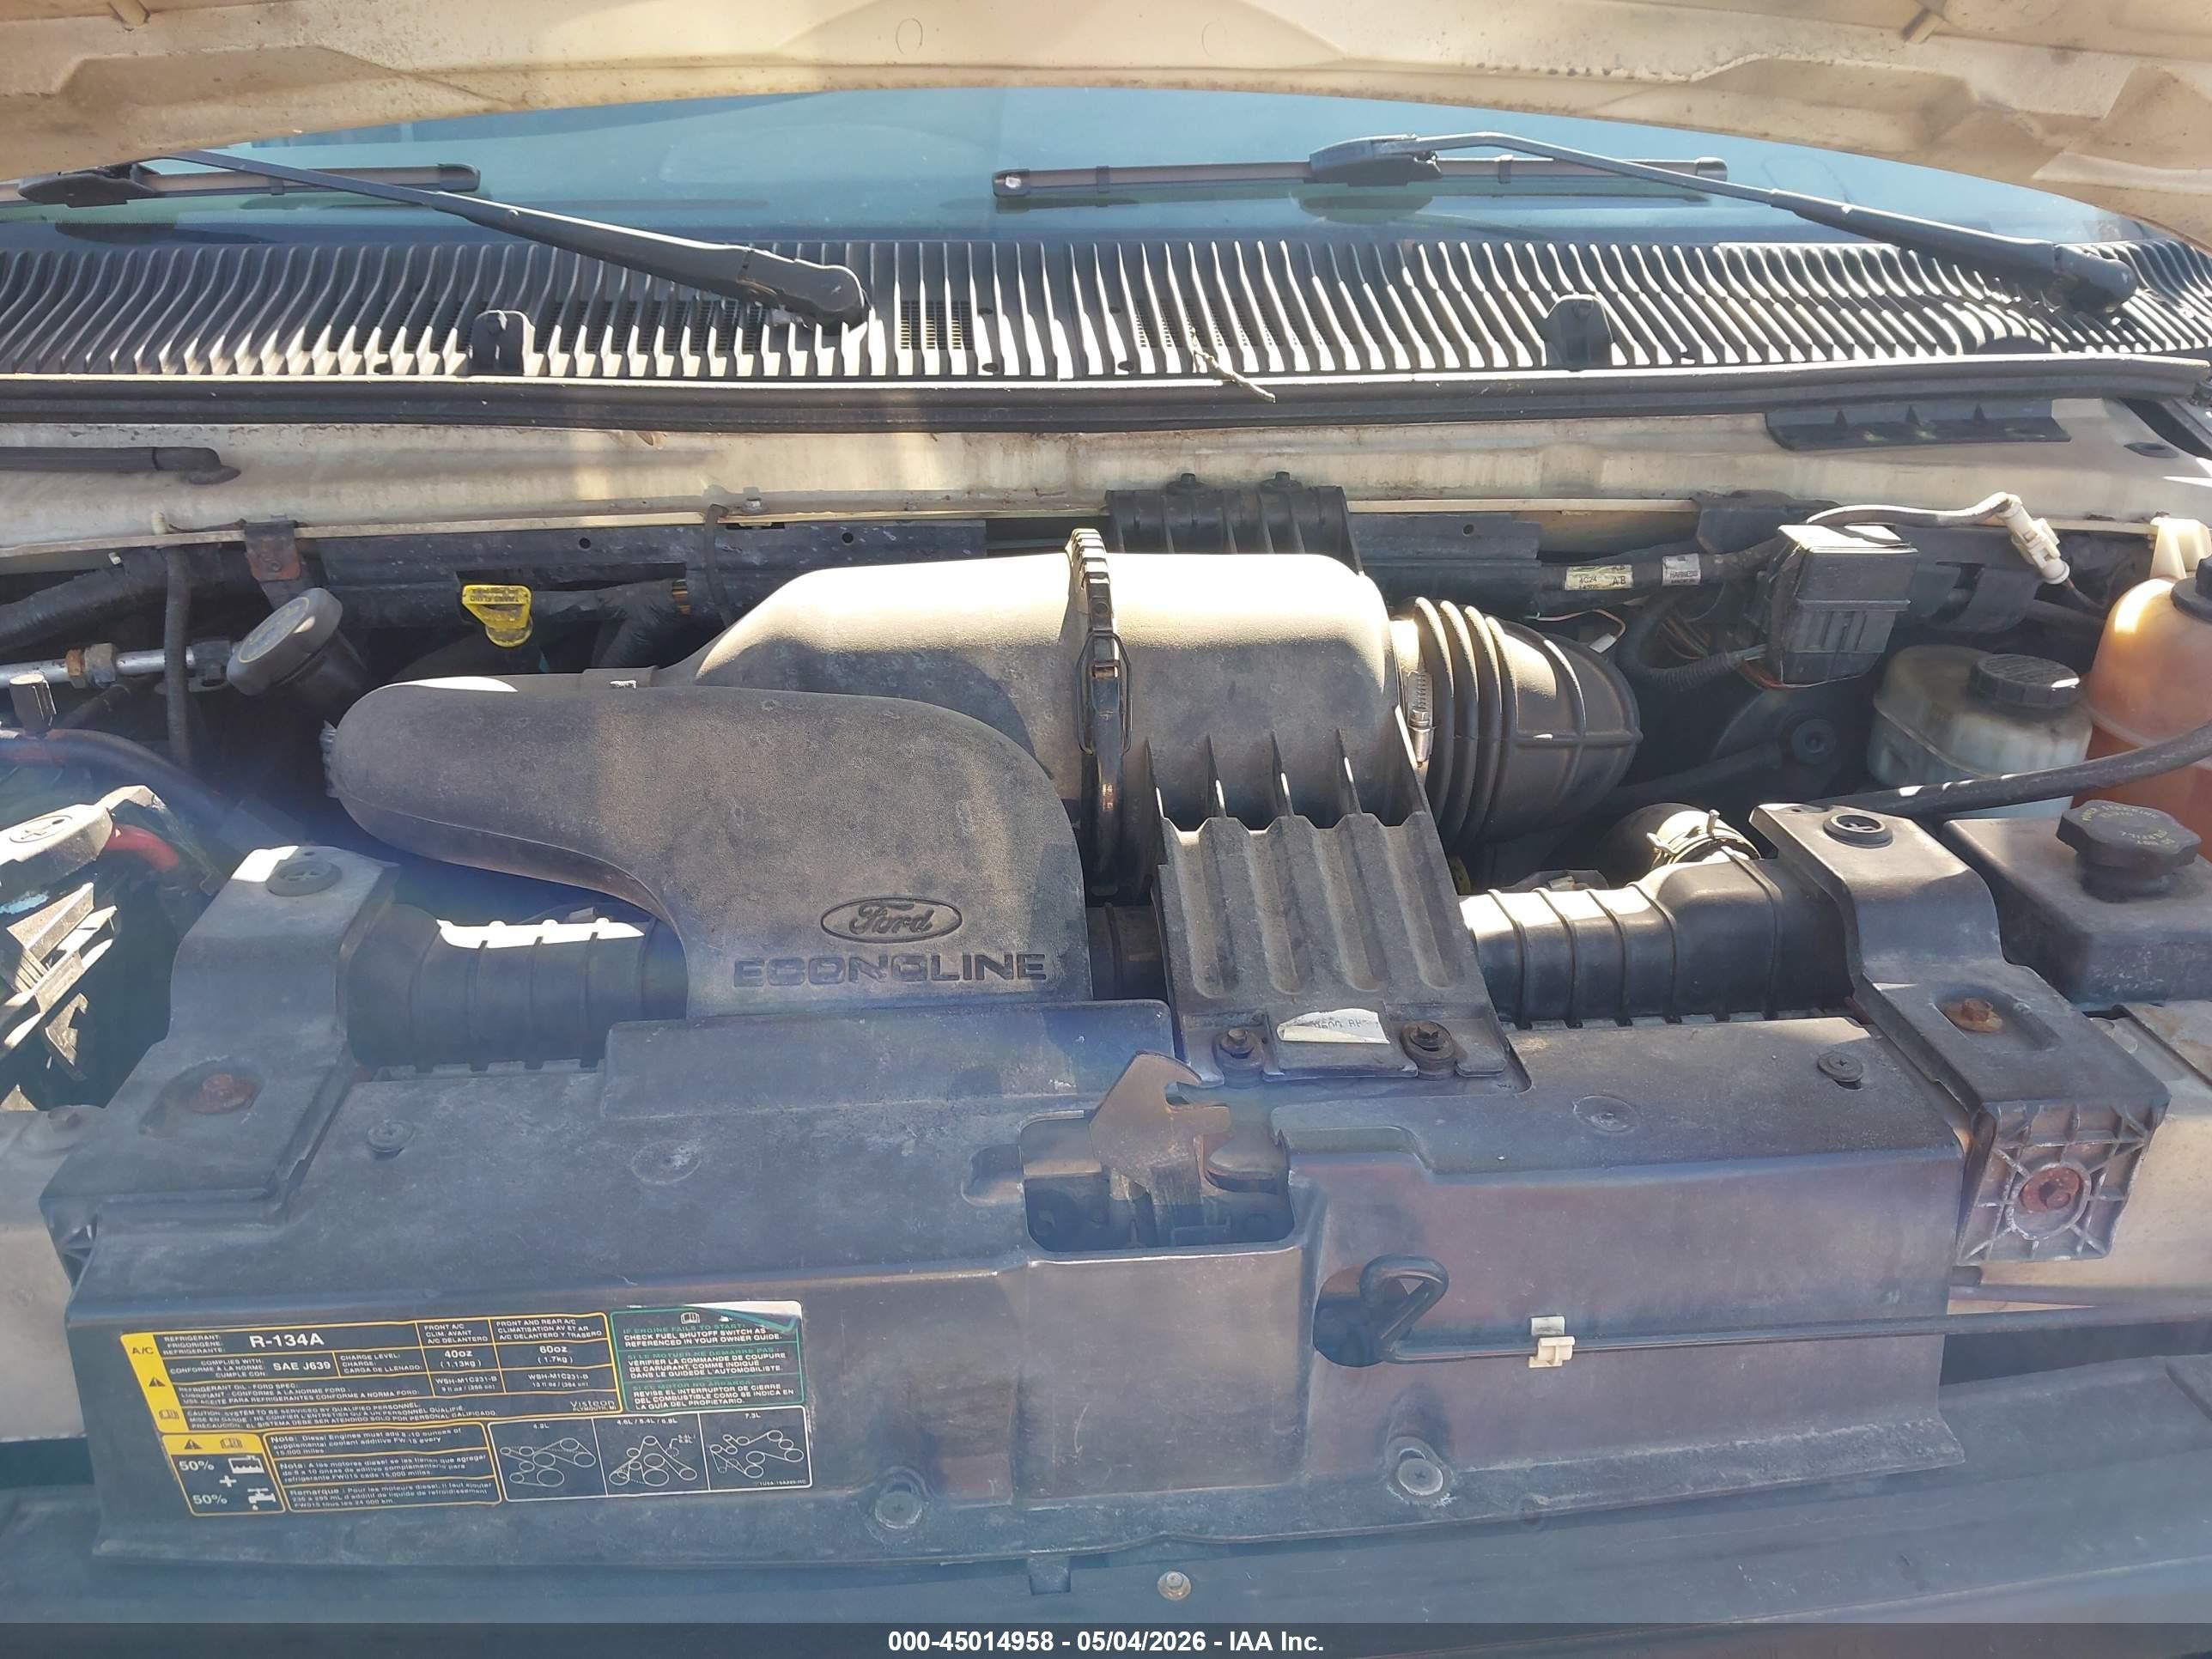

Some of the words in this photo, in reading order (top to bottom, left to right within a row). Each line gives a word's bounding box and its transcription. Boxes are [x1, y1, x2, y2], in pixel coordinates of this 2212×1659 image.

[848, 902, 935, 935] Ford
[733, 953, 1047, 988] ECONOLINE
[679, 1330, 720, 1339] SHUTOFF
[249, 1333, 325, 1348] R-134A
[444, 1350, 473, 1358] 40oz
[273, 1362, 300, 1371] SAE
[303, 1361, 331, 1370] J639
[678, 1386, 736, 1395] INTERRUPTOR
[251, 1395, 313, 1403] REFRIGERANTES
[653, 1393, 712, 1402] COMBUSTIBLE
[179, 1461, 215, 1471] 50%
[192, 1494, 228, 1504] 50%
